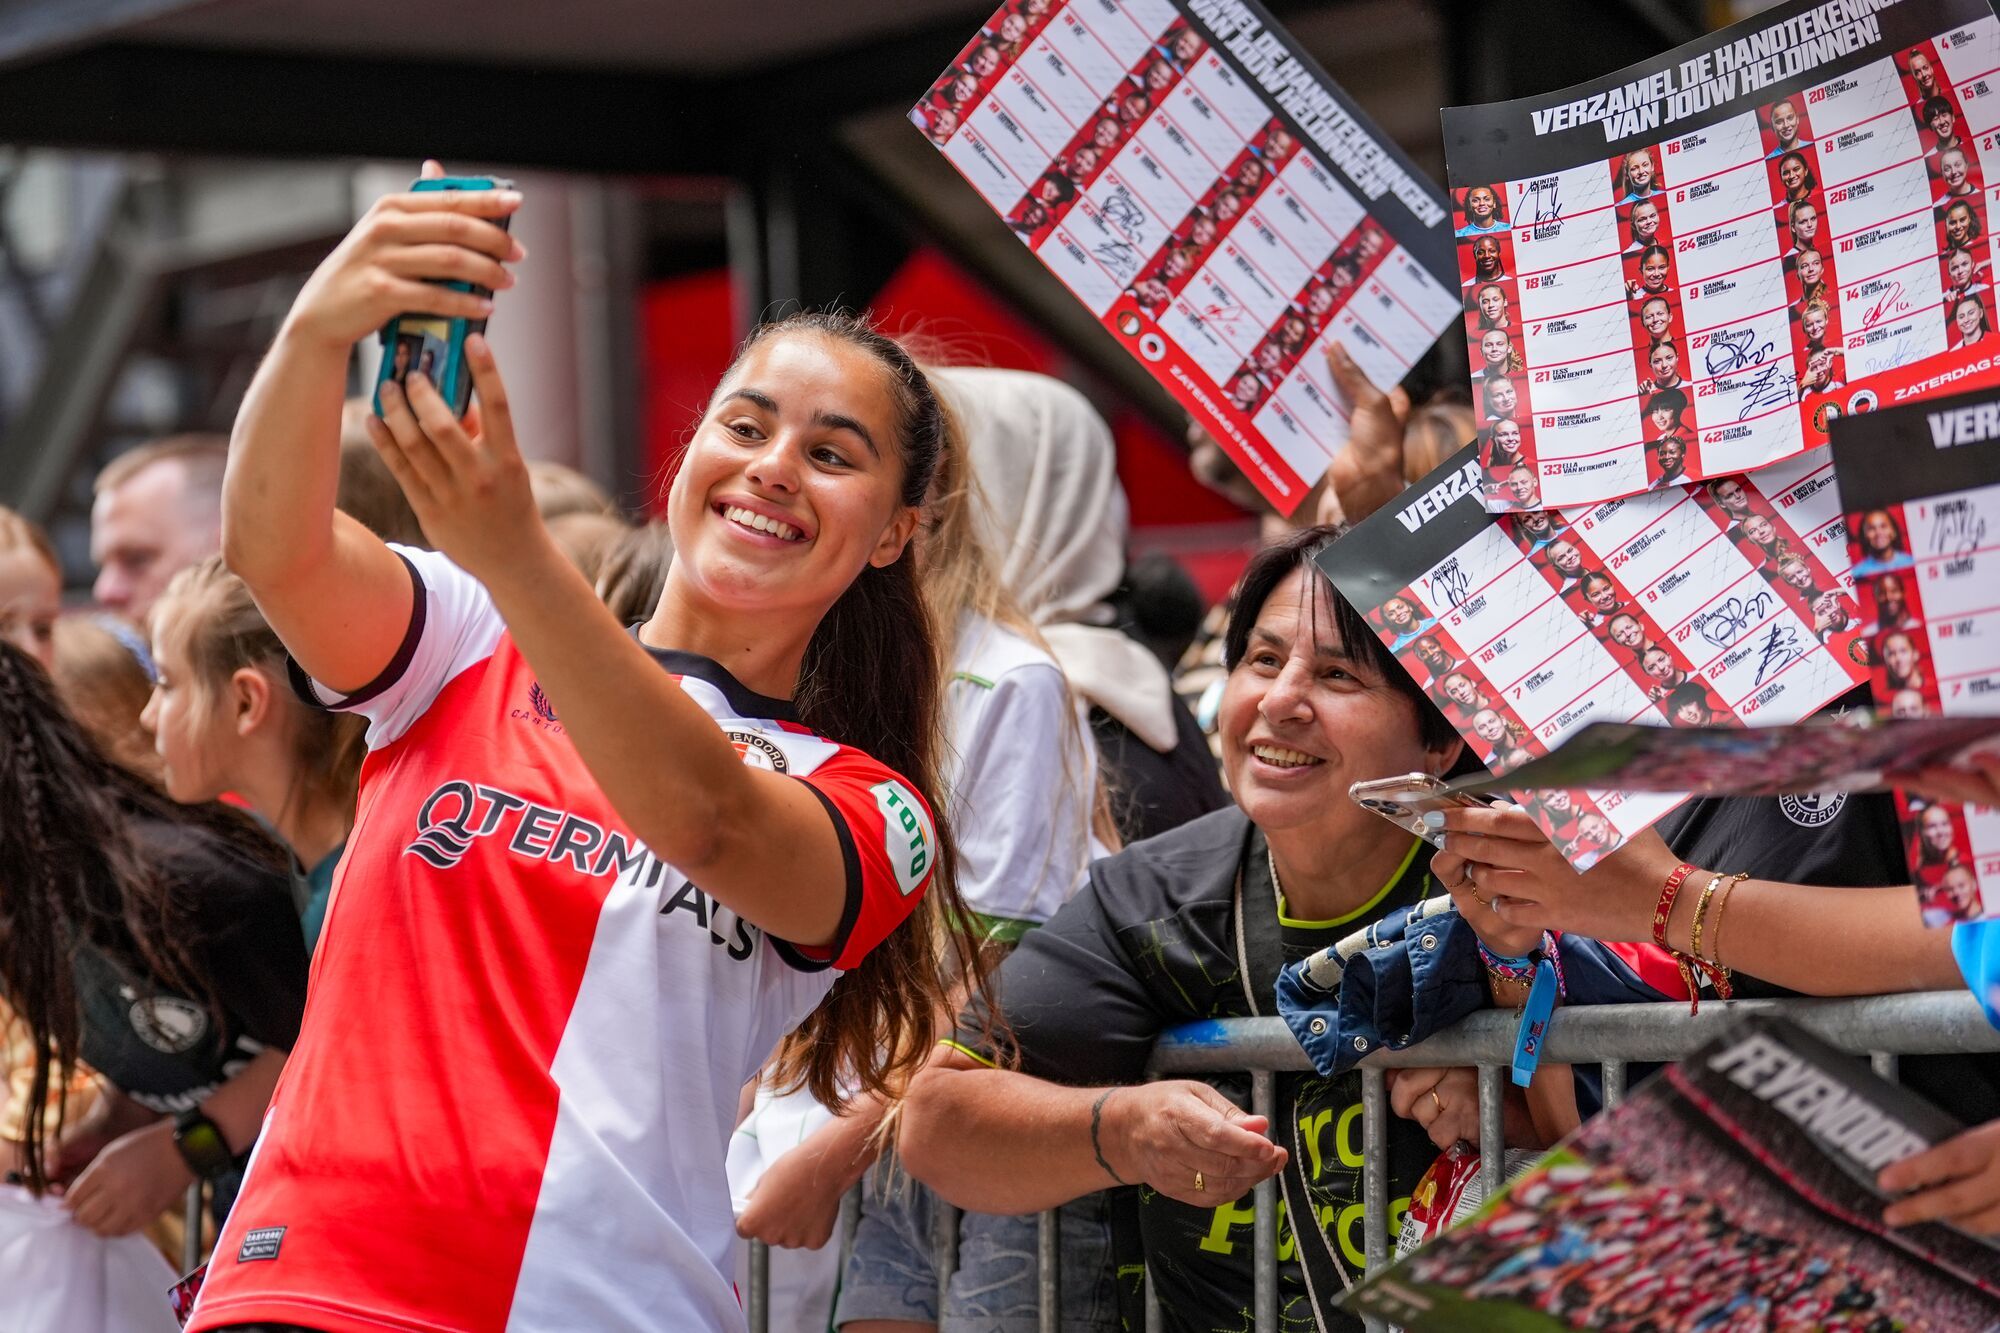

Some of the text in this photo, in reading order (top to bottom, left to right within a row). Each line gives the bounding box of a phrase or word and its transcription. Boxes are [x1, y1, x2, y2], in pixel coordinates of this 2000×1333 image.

[1941, 38, 1949, 50] 4
[1530, 0, 1904, 136] VERZAMEL DE HANDTEKENIN
[1601, 13, 1882, 142] VAN JOUW HELDINNEN!
[1808, 88, 1826, 104] 20
[1961, 86, 1975, 100] 15
[1681, 134, 1699, 145] ROOS
[1837, 131, 1857, 144] EMMA
[1984, 137, 1993, 151] 2
[1666, 141, 1681, 155] 16
[1825, 140, 1834, 153] 8
[1517, 183, 1524, 195] 1
[1847, 181, 1869, 193] SANNE
[1676, 190, 1686, 203] 6
[1829, 189, 1847, 205] 26
[1521, 230, 1531, 243] 5
[1696, 229, 1722, 242] BRIDGET
[1709, 230, 1739, 245] BAPTISTE
[1854, 229, 1881, 243] KIRSTEN
[1678, 238, 1697, 253] 24
[1839, 239, 1854, 253] 10
[1855, 237, 1869, 249] VAN
[1525, 278, 1540, 290] 18
[1703, 279, 1725, 291] SANNE
[1703, 282, 1736, 296] KOOPMAN
[1689, 287, 1699, 300] 9
[1845, 288, 1859, 302] 14
[1532, 324, 1542, 336] 7
[1710, 329, 1728, 340] TALIA
[1866, 335, 1880, 345] VAN
[1889, 325, 1913, 338] LAVOIR
[1692, 335, 1710, 349] 27
[1848, 335, 1866, 350] 25
[1535, 371, 1550, 383] 21
[1552, 368, 1593, 381] VAN BENTEM
[1894, 359, 1991, 401] ZATERDAG
[1698, 383, 1717, 397] 23
[1716, 379, 1732, 388] MAO
[1540, 416, 1555, 428] 19
[1703, 431, 1723, 444] 42
[1722, 426, 1747, 436] ESTHER
[1543, 463, 1562, 476] 33
[1563, 459, 1618, 475] VAN KERKHOVEN
[1792, 479, 1818, 497] KIRSTEN
[1815, 472, 1840, 490] WESTE
[1395, 459, 1483, 533] VERZA
[1778, 493, 1796, 509] 10
[1583, 517, 1595, 531] 6
[1812, 533, 1828, 547] 14
[1610, 552, 1630, 570] 24
[1420, 578, 1430, 589] 1
[1661, 570, 1691, 595] KOOPMAN
[1646, 590, 1658, 603] 9
[1450, 613, 1462, 626] 5
[1675, 624, 1691, 643] 27
[1479, 648, 1495, 664] 18
[1708, 661, 1727, 680] 23
[1512, 687, 1522, 700] 7
[1742, 698, 1760, 716] 42
[511, 709, 567, 736] CASTO
[1542, 722, 1558, 739] 21
[727, 732, 785, 768] ENOORD
[884, 787, 929, 880] TOTO
[404, 779, 754, 962] QTERMIALS
[1707, 1033, 1931, 1173] FEYENOOR
